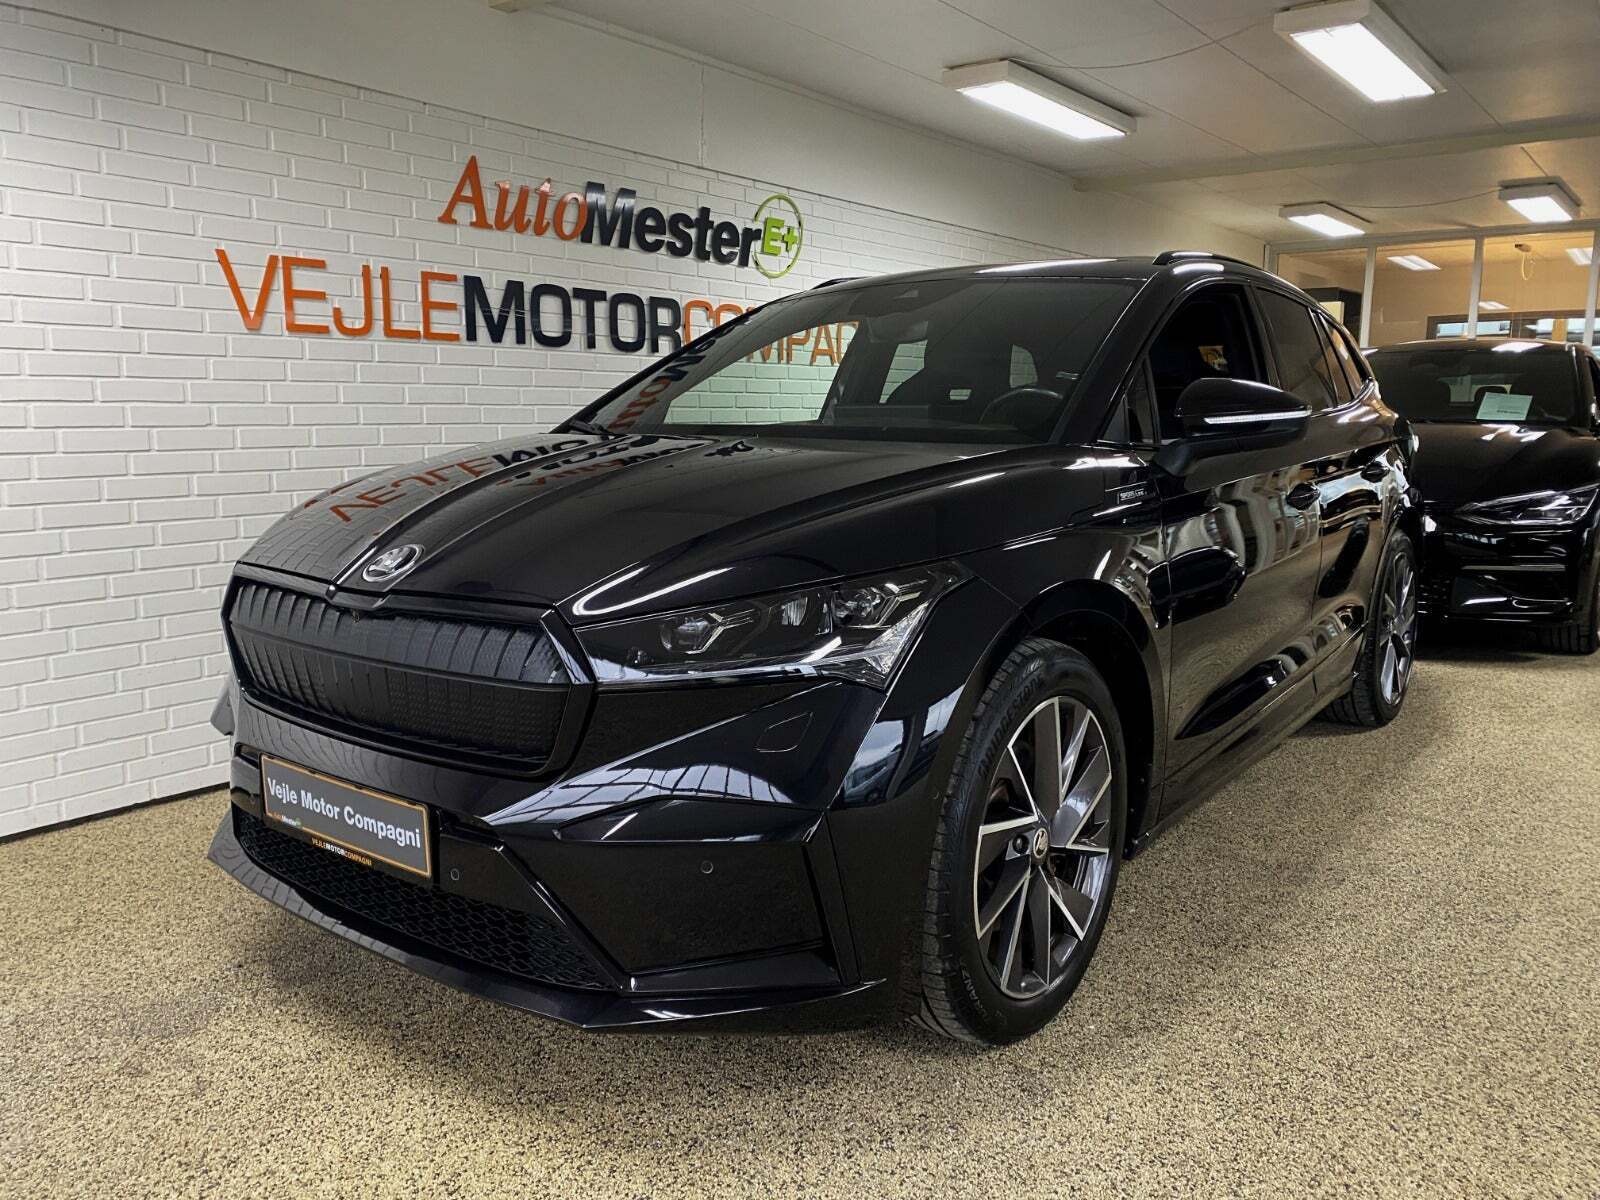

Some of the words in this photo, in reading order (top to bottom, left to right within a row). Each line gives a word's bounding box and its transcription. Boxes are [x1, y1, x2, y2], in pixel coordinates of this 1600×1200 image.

[439, 155, 761, 267] AutoMester
[267, 777, 298, 805] Vejle
[301, 790, 340, 820] Motor
[343, 806, 421, 848] Compagni
